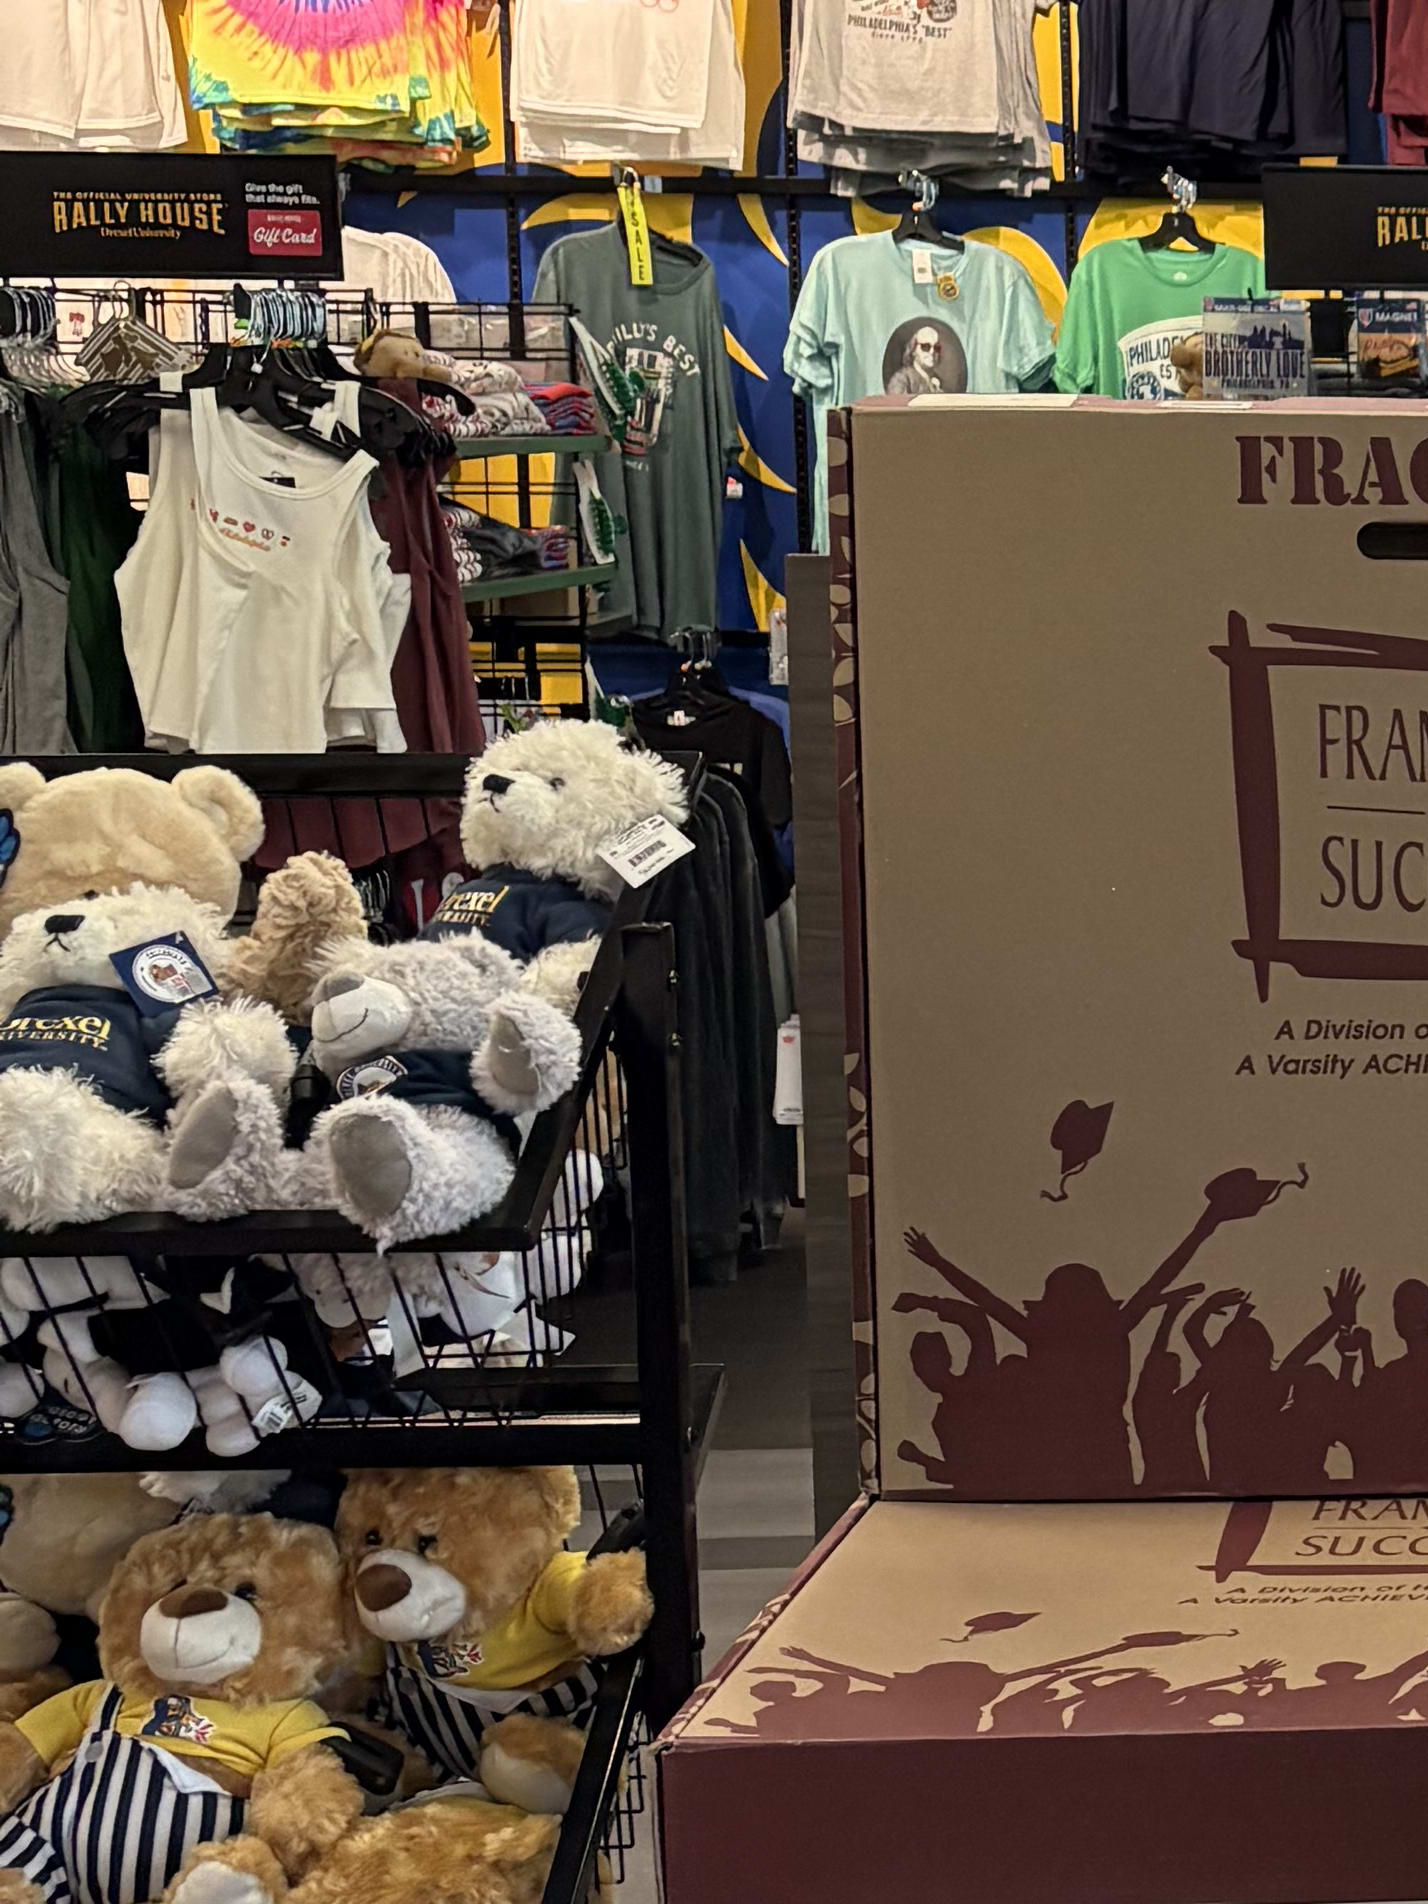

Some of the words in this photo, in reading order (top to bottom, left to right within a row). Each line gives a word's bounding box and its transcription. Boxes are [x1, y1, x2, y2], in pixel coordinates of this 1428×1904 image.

[847, 14, 919, 35] PHILADELPHIA'S
[53, 200, 130, 234] RALLY
[139, 201, 226, 235] HOUSE
[253, 226, 283, 248] Gift
[283, 226, 316, 244] Card
[629, 212, 647, 281] SALE
[663, 334, 701, 378] BEST
[1204, 348, 1273, 379] BROTHERLY
[1276, 348, 1306, 379] LOVE
[1274, 1019, 1295, 1041] A
[1303, 1018, 1406, 1041] Division
[1234, 1054, 1256, 1076] A
[1267, 1053, 1356, 1080] Varsity
[1214, 1594, 1312, 1606] Varsity
[1232, 1586, 1247, 1594] A
[1259, 1584, 1368, 1594] Division
[1376, 1583, 1408, 1593] of
